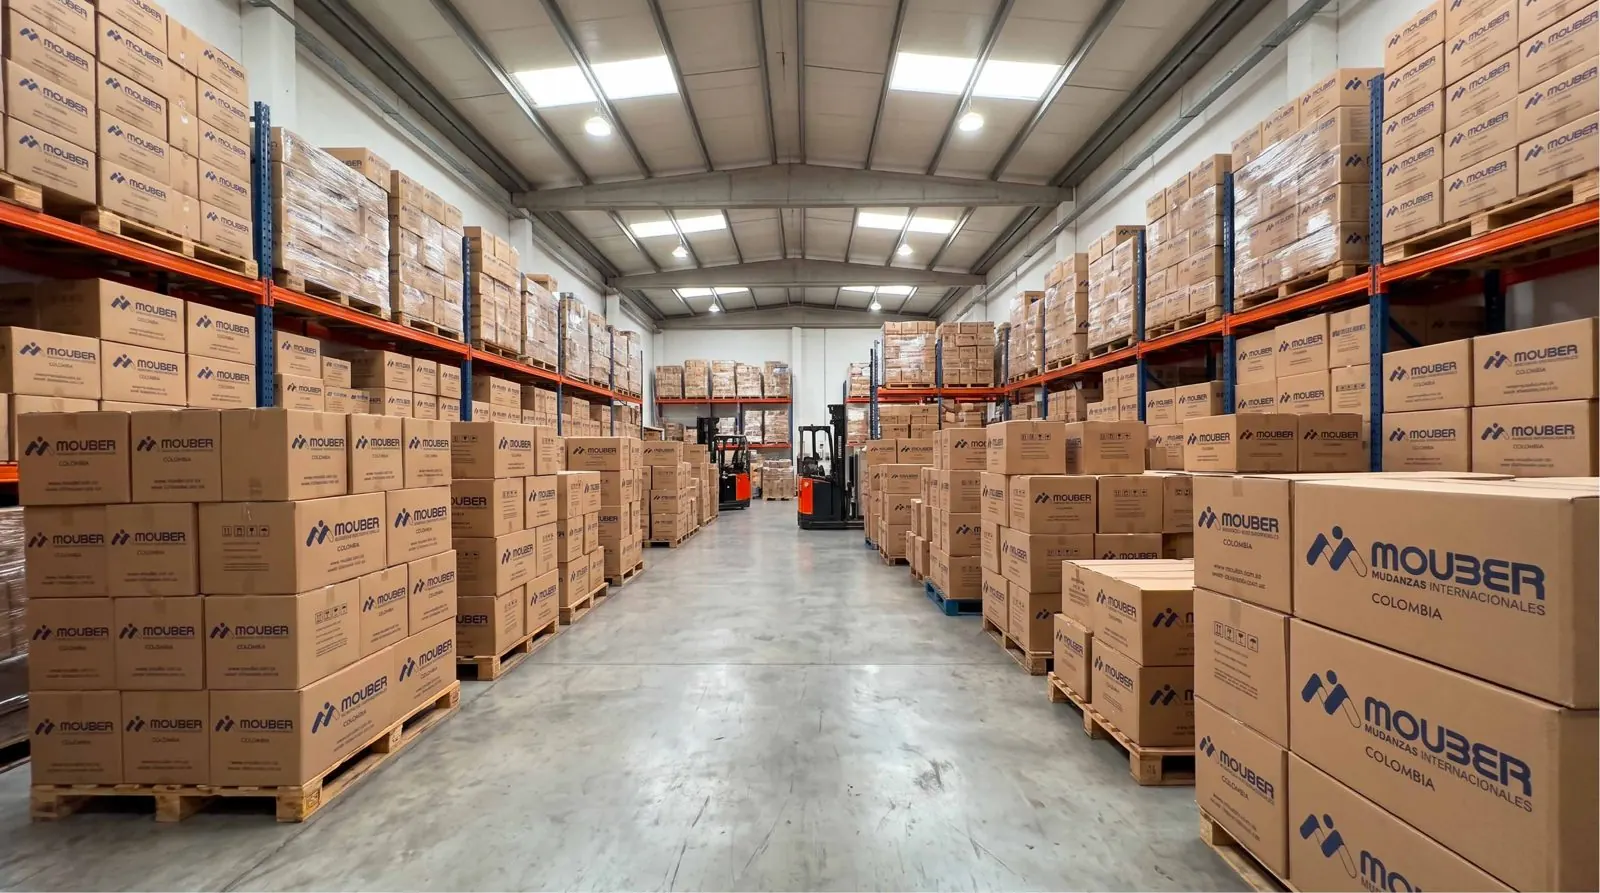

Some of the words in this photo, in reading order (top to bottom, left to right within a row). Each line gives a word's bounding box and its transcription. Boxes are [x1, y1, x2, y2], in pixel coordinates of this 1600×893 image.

[1468, 11, 1510, 41] MOUBER
[1548, 11, 1598, 43] MOUBER
[44, 38, 89, 69] MOUBER
[1469, 62, 1510, 89] MOUBER
[1548, 68, 1598, 96] MOUBER
[43, 87, 88, 116] MOUBER
[124, 86, 162, 112] MOUBER
[1468, 112, 1508, 136] MOUBER
[127, 132, 164, 157] MOUBER
[1548, 123, 1598, 149] MOUBER
[43, 143, 89, 168] MOUBER
[1466, 161, 1507, 183] MOUBER
[129, 178, 166, 199] MOUBER
[1400, 192, 1433, 210] MOUBER
[220, 215, 249, 232] MOUBER
[136, 302, 177, 319] MOUBER
[216, 321, 249, 334] MOUBER
[1292, 335, 1323, 349] MOUBER
[47, 348, 96, 361] MOUBER
[1514, 344, 1578, 362] MOUBER
[137, 360, 178, 372] MOUBER
[1411, 362, 1456, 375] MOUBER
[216, 370, 250, 381] MOUBER
[1293, 390, 1325, 400] MOUBER
[1200, 433, 1230, 442] MOUBER
[1256, 431, 1293, 439] MOUBER
[1410, 429, 1456, 439] MOUBER
[1512, 425, 1575, 437] MOUBER
[56, 440, 116, 451] MOUBER
[161, 439, 213, 448] MOUBER
[310, 438, 344, 447] MOUBER
[371, 438, 400, 447] MOUBER
[452, 497, 487, 506] OUBER
[414, 507, 447, 520] MOUBER
[335, 517, 380, 535] MOUBER
[1222, 512, 1279, 533] MOUBER
[53, 534, 104, 545] MOUBER
[135, 532, 186, 542] MOUBER
[1223, 538, 1253, 550] COLOMBIA
[1372, 541, 1545, 600] MOUBER
[427, 572, 455, 587] MOUBER
[377, 587, 405, 603] MOUBER
[1372, 570, 1426, 590] MUDANZAS
[1429, 581, 1546, 616] INTERNACIONALES
[1108, 596, 1137, 616] MOUBER
[1372, 593, 1442, 621] COLOMBIA
[456, 615, 488, 624] UBER
[57, 628, 109, 638] MOUBER
[143, 626, 195, 636] MOUBER
[236, 626, 288, 635] MOUBER
[420, 639, 452, 666] MOUBER
[1105, 664, 1134, 691] MOUBER
[341, 676, 388, 712] MOUBER
[60, 722, 113, 732] MOUBER
[150, 720, 203, 730] MOUBER
[240, 719, 293, 729] MOUBER
[1364, 696, 1532, 797] MOUBER
[1220, 750, 1275, 799] MOUBER
[1364, 724, 1418, 757] MUDANZAS
[1420, 750, 1532, 813] INTERNACIONALES
[1366, 746, 1435, 792] COLOMBIA
[1222, 776, 1249, 800] COLOMBIA
[1361, 851, 1422, 893] MO
